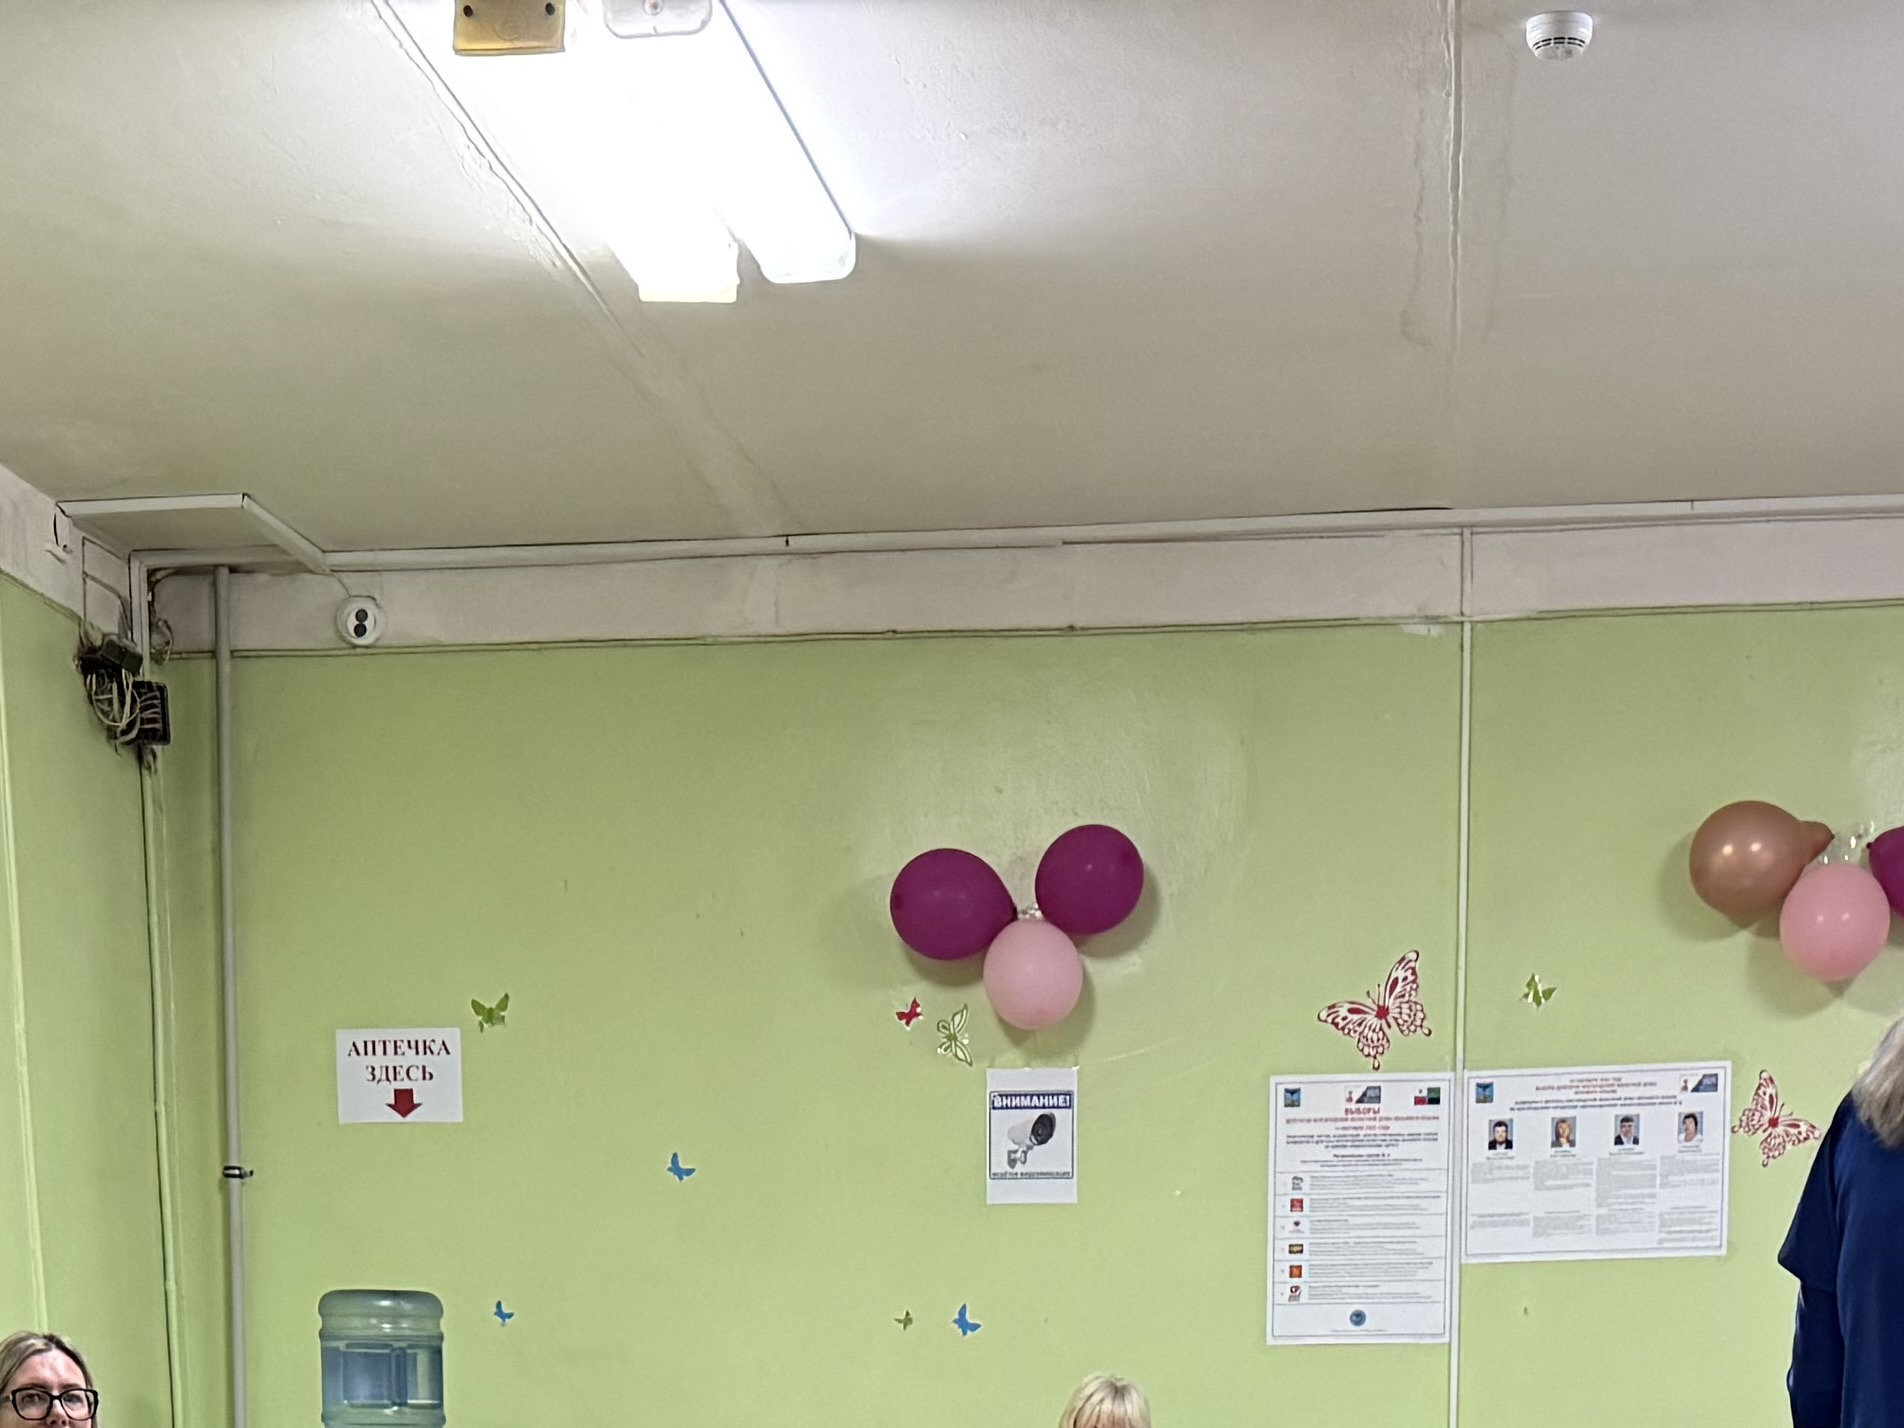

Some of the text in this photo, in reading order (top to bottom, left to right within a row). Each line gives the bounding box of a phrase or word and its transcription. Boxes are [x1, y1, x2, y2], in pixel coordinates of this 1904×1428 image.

[347, 1039, 451, 1057] АПТЕЧКА
[365, 1064, 434, 1085] ЗДЕСЬ
[992, 1094, 1071, 1108] ВНИМАНИЕ!
